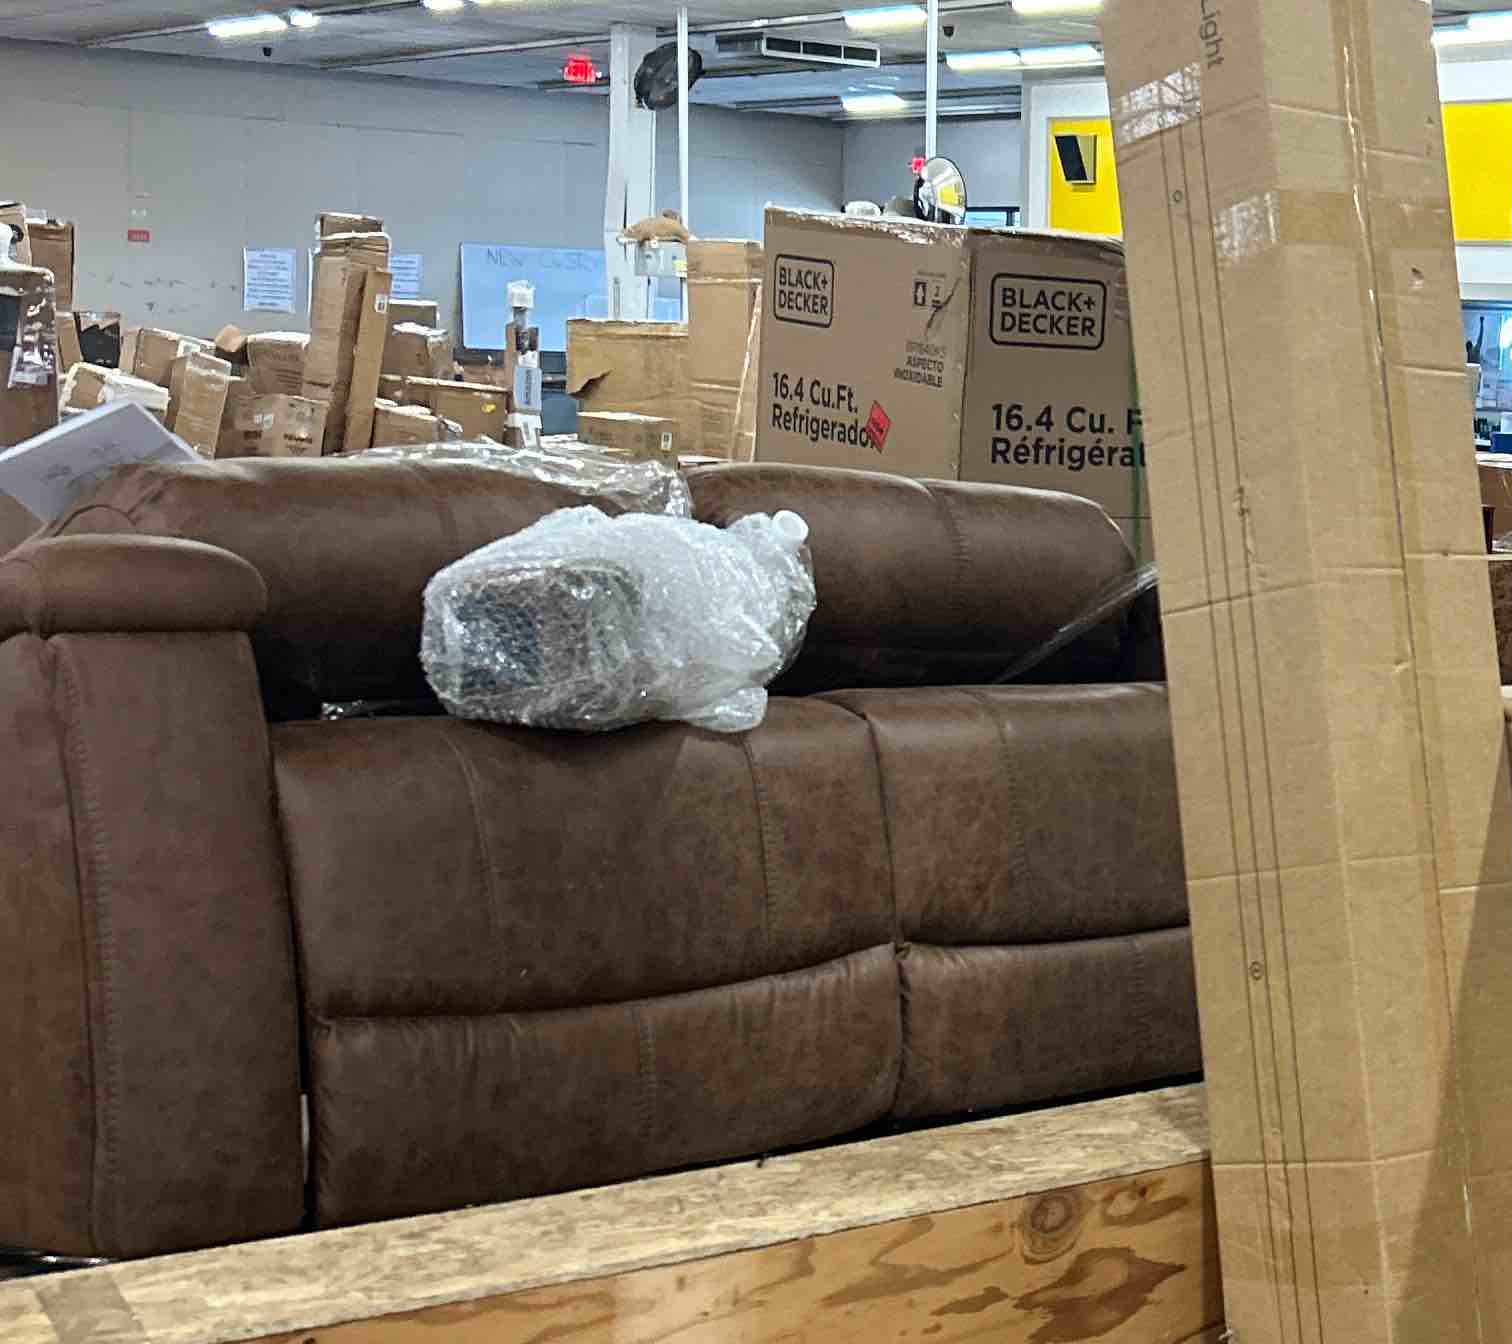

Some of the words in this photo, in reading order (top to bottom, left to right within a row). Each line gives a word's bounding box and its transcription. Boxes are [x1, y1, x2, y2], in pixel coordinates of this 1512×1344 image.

[778, 266, 829, 292] BLACK+
[778, 289, 829, 316] DECKER
[1002, 287, 1097, 313] BLACK+
[1000, 311, 1097, 338] DECKER
[772, 372, 804, 403] 16.4
[809, 378, 859, 414] Cu.Ft.
[990, 403, 1055, 433] 16.4
[1065, 406, 1115, 435] Cu.
